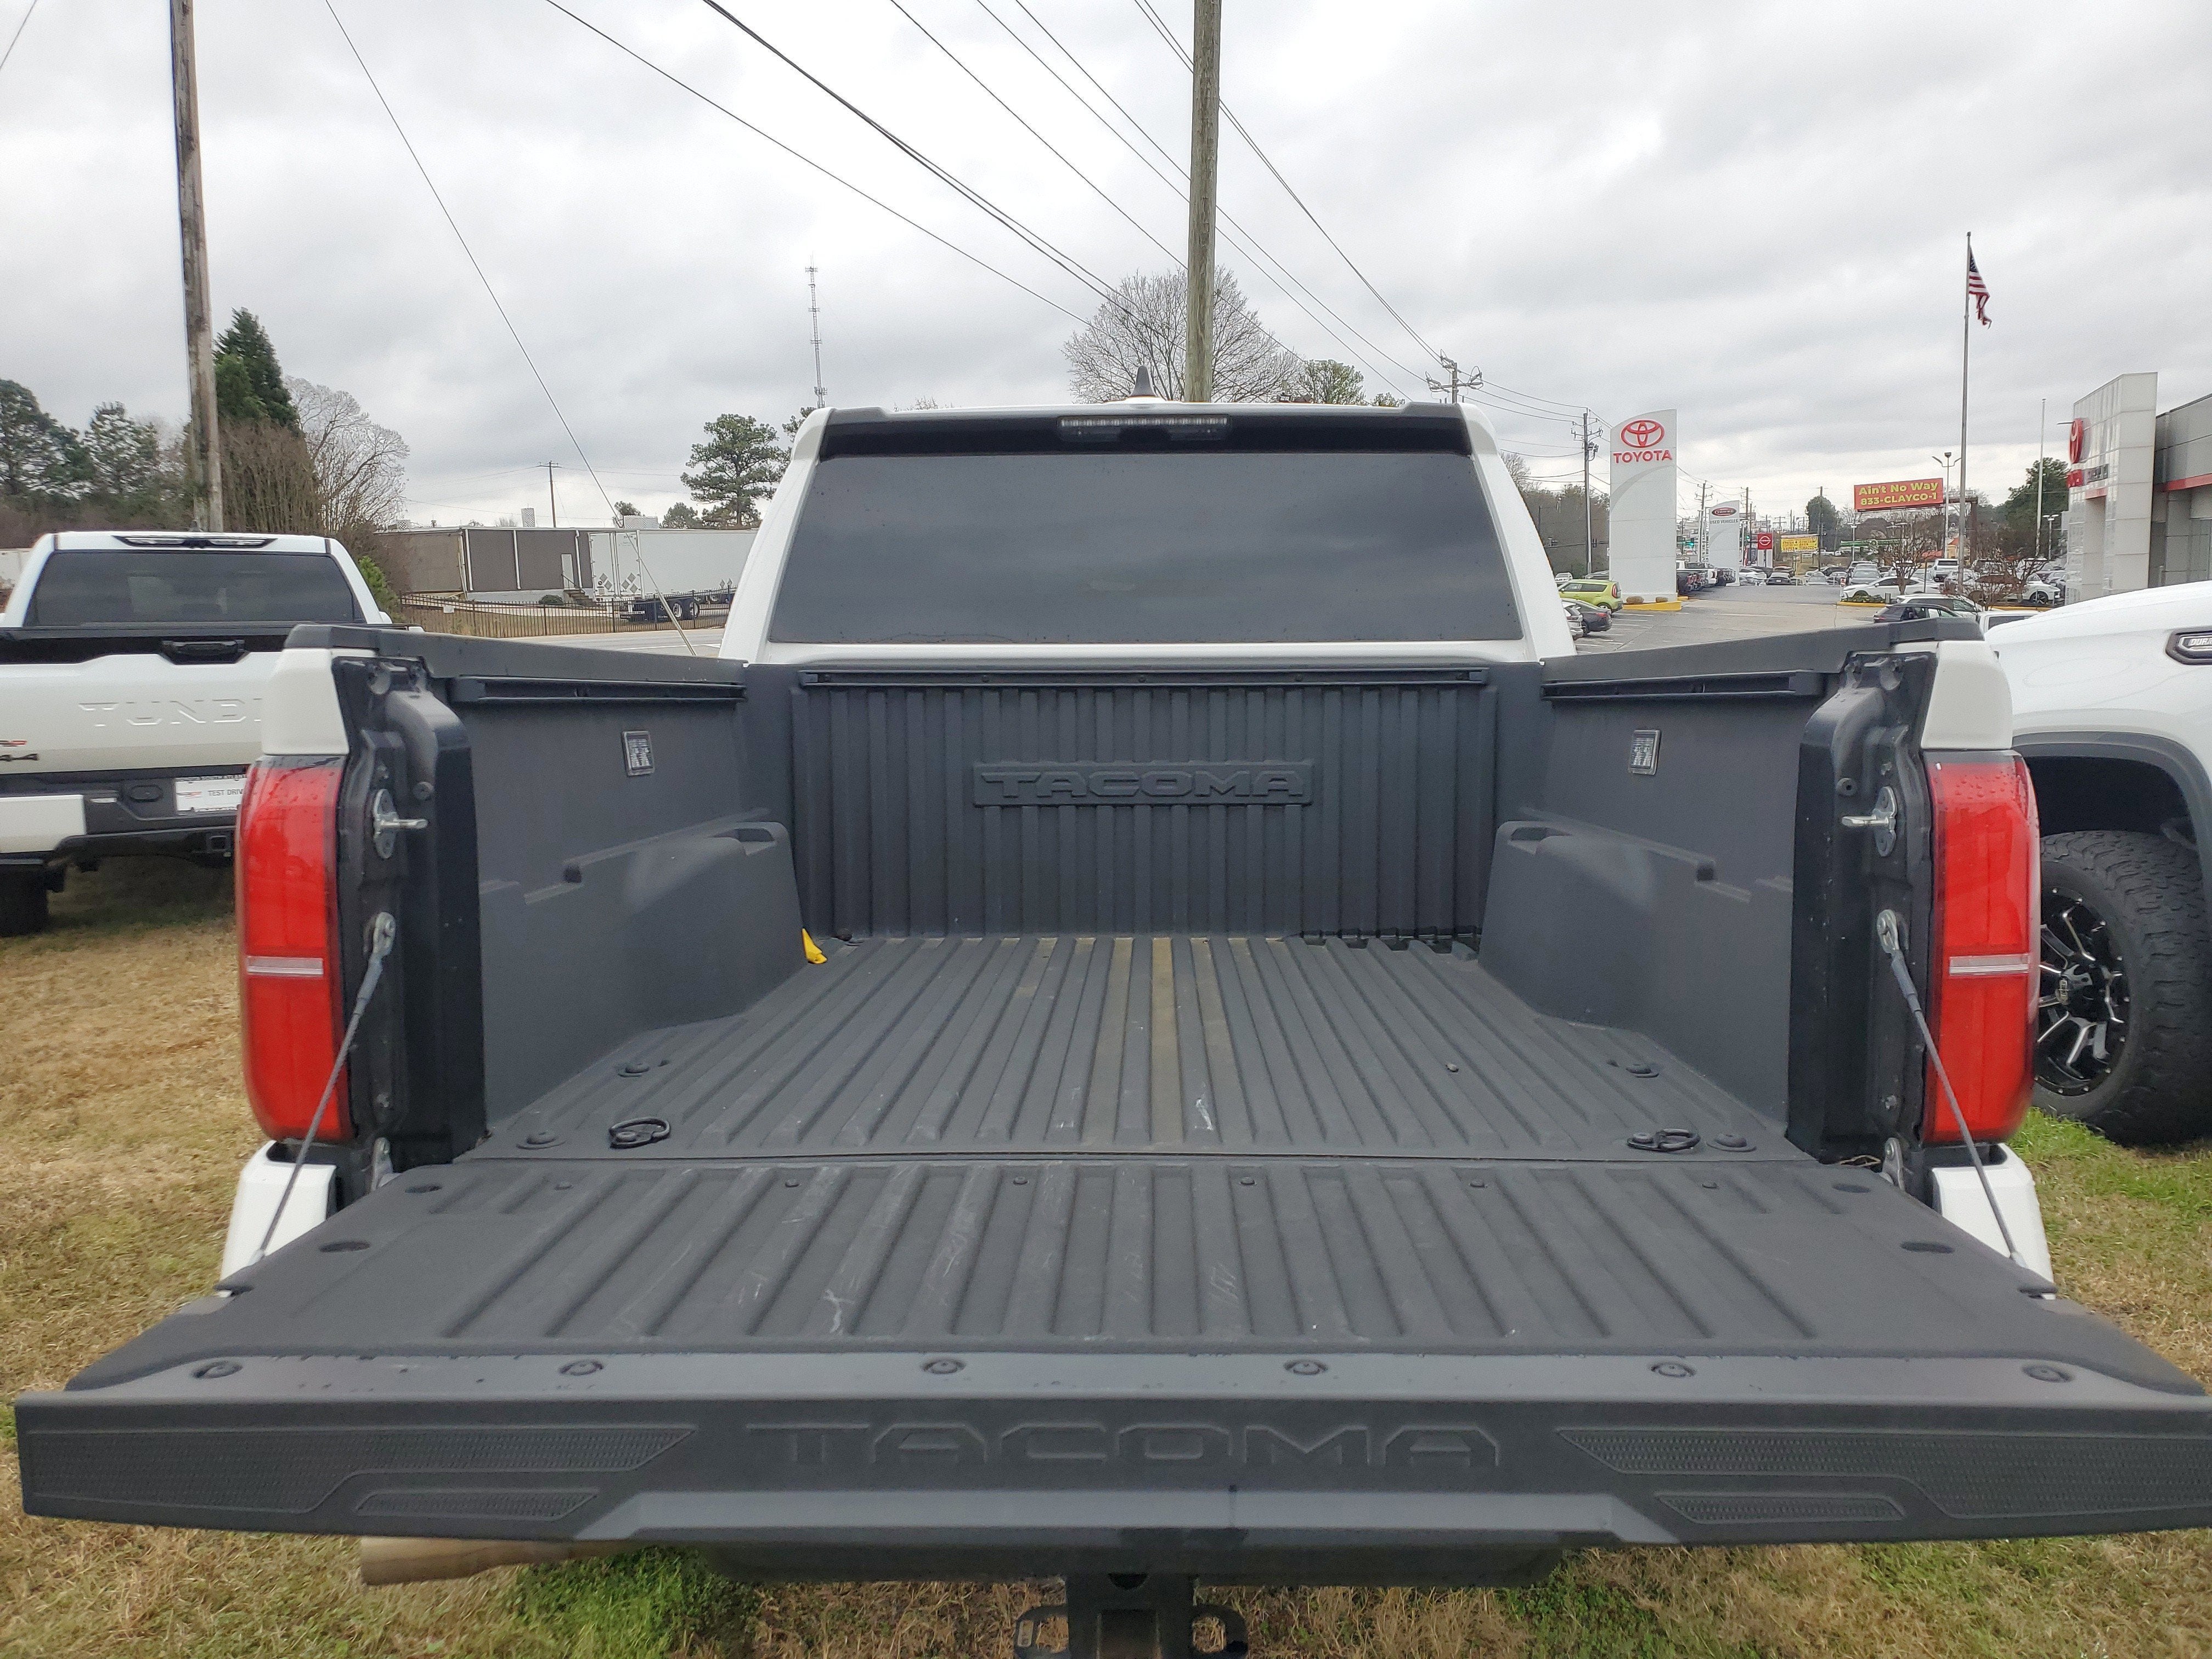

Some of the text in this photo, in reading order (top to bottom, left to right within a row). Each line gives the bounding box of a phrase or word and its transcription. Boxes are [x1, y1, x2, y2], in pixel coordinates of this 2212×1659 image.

[1613, 450, 1672, 463] TOYOTA
[1859, 482, 1938, 495] Ain't No Way
[1860, 492, 1937, 505] 833-CLAYCO-1
[981, 770, 1303, 798] TACOMA
[747, 1423, 1499, 1466] TACOMA
